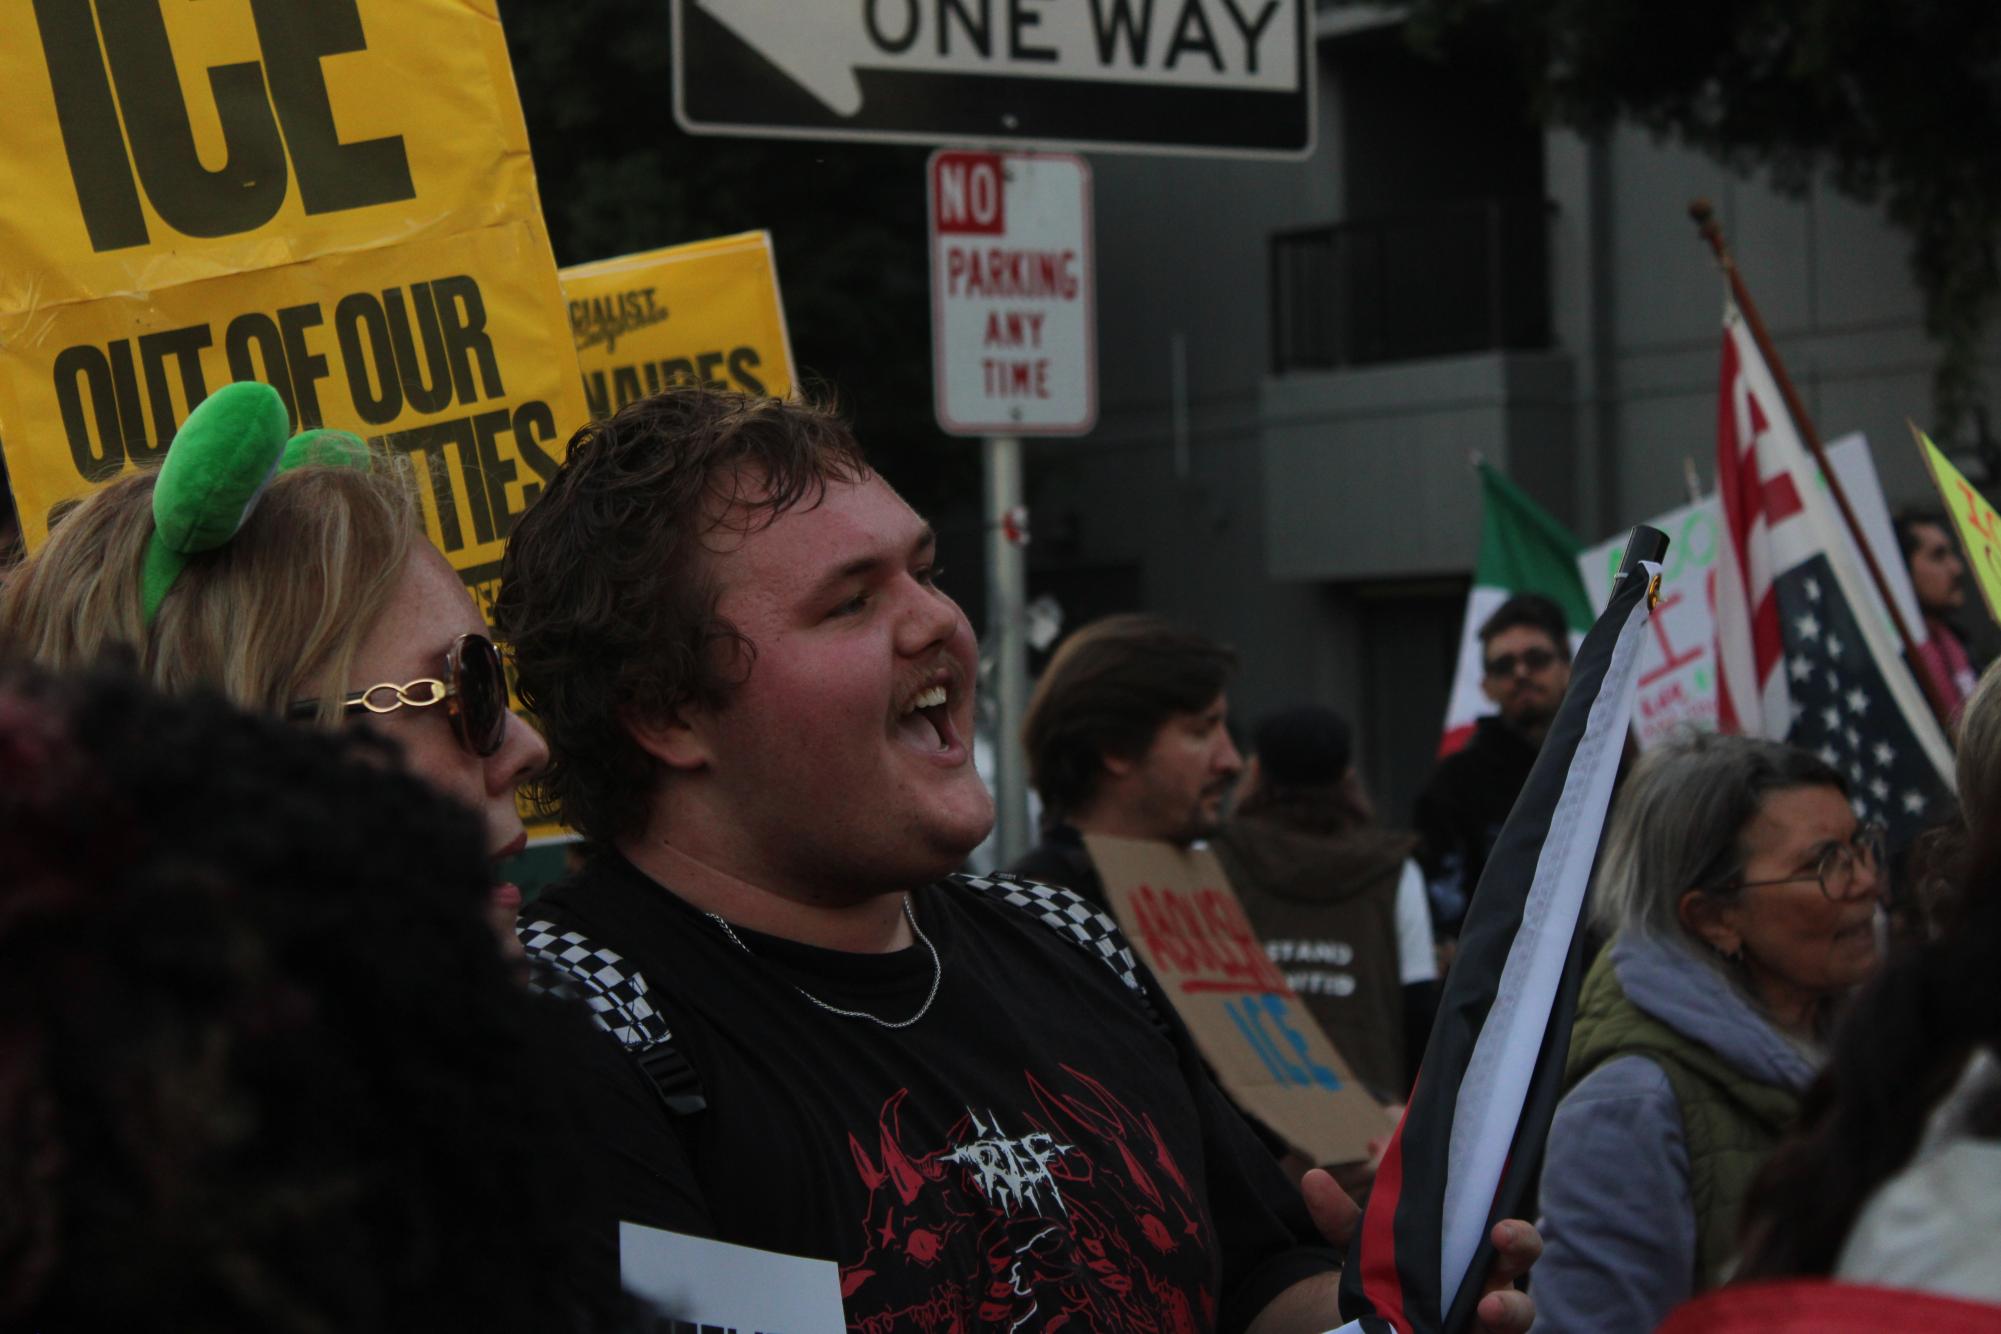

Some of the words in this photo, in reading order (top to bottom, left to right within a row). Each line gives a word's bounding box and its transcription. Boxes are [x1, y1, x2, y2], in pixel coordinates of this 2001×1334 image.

[862, 0, 1059, 62] ONE
[1089, 0, 1280, 74] WAY
[32, 0, 416, 253] ICE
[938, 163, 998, 224] NO
[947, 248, 1077, 300] PARKING
[984, 311, 1045, 349] ANY
[53, 323, 213, 484] OUT
[225, 302, 330, 438] OF
[334, 275, 506, 425] OUR
[982, 358, 1052, 398] TIME
[1223, 993, 1343, 1090] ICE
